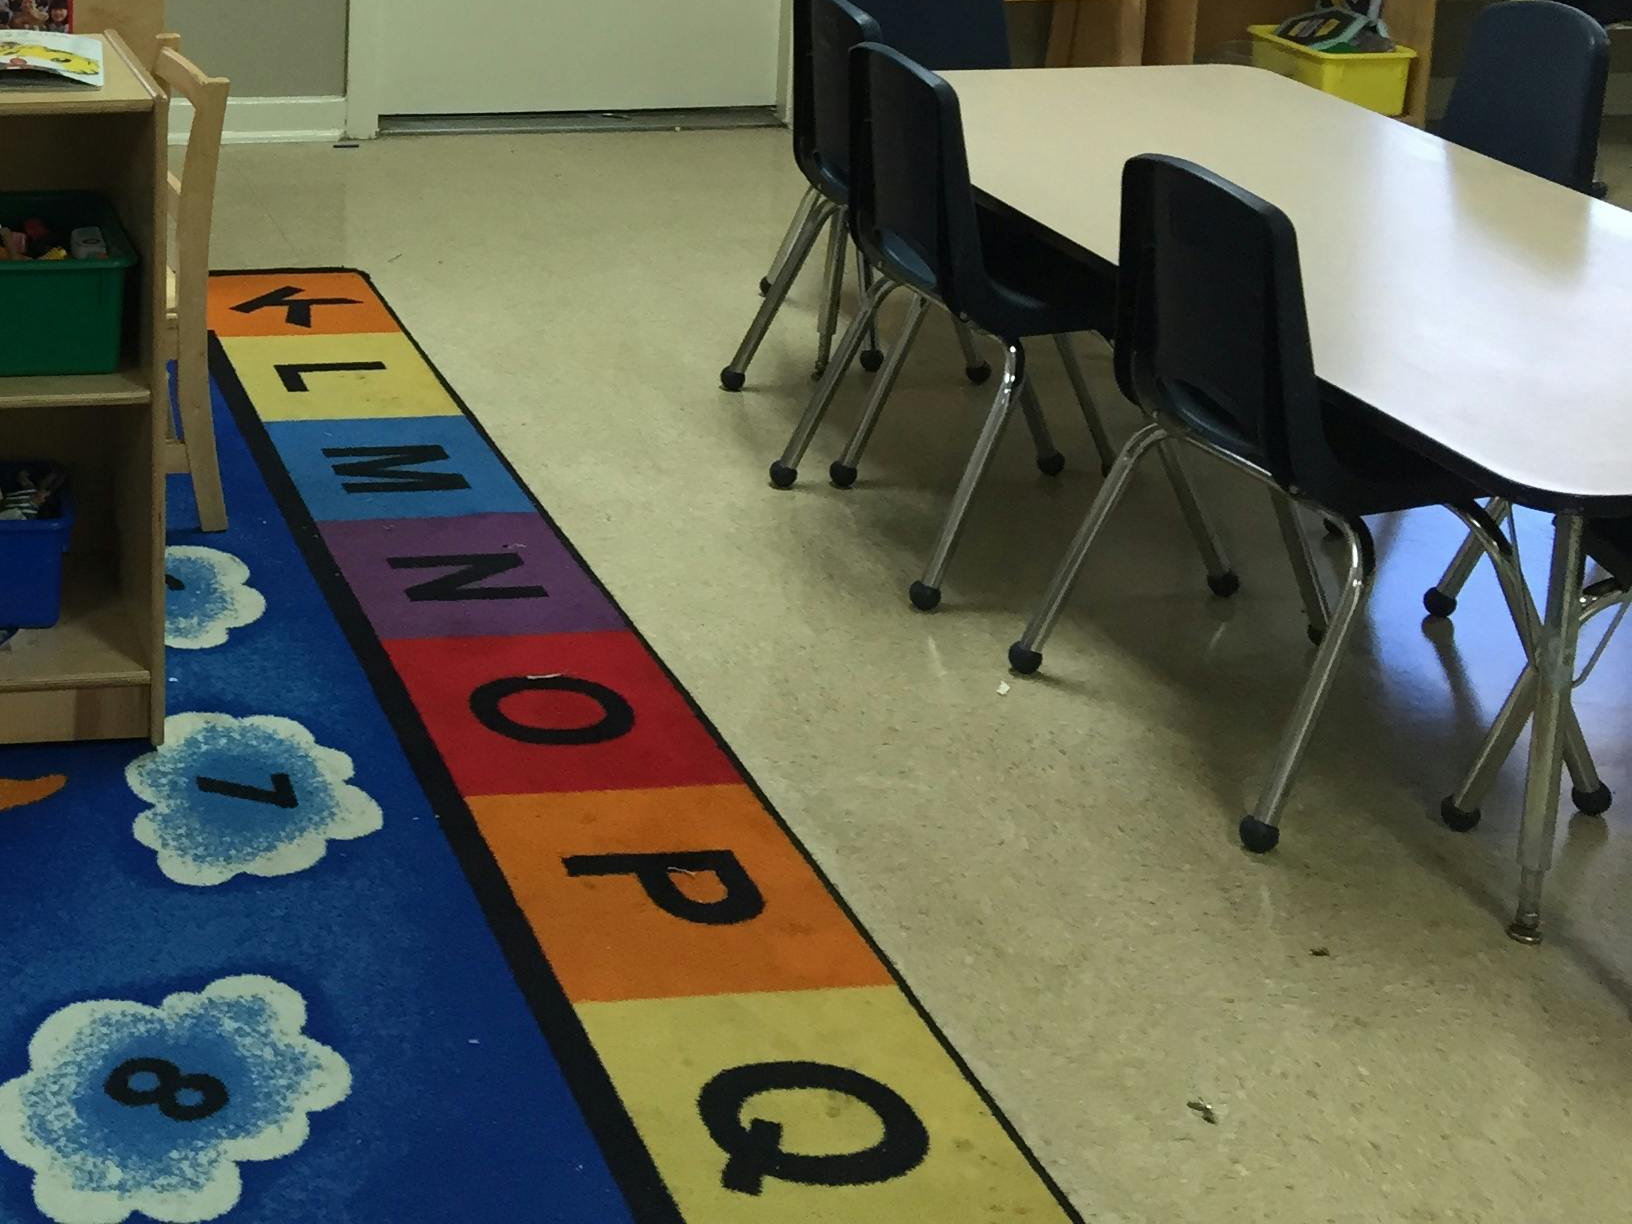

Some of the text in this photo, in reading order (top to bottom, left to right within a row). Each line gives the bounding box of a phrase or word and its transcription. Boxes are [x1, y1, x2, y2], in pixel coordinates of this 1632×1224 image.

[229, 285, 364, 328] K
[274, 361, 386, 393] L
[321, 445, 472, 494] M
[386, 552, 549, 603] N
[469, 676, 635, 746] O
[195, 773, 299, 810] 7
[561, 849, 766, 926] P
[103, 1057, 230, 1122] 8
[697, 1061, 930, 1197] Q
